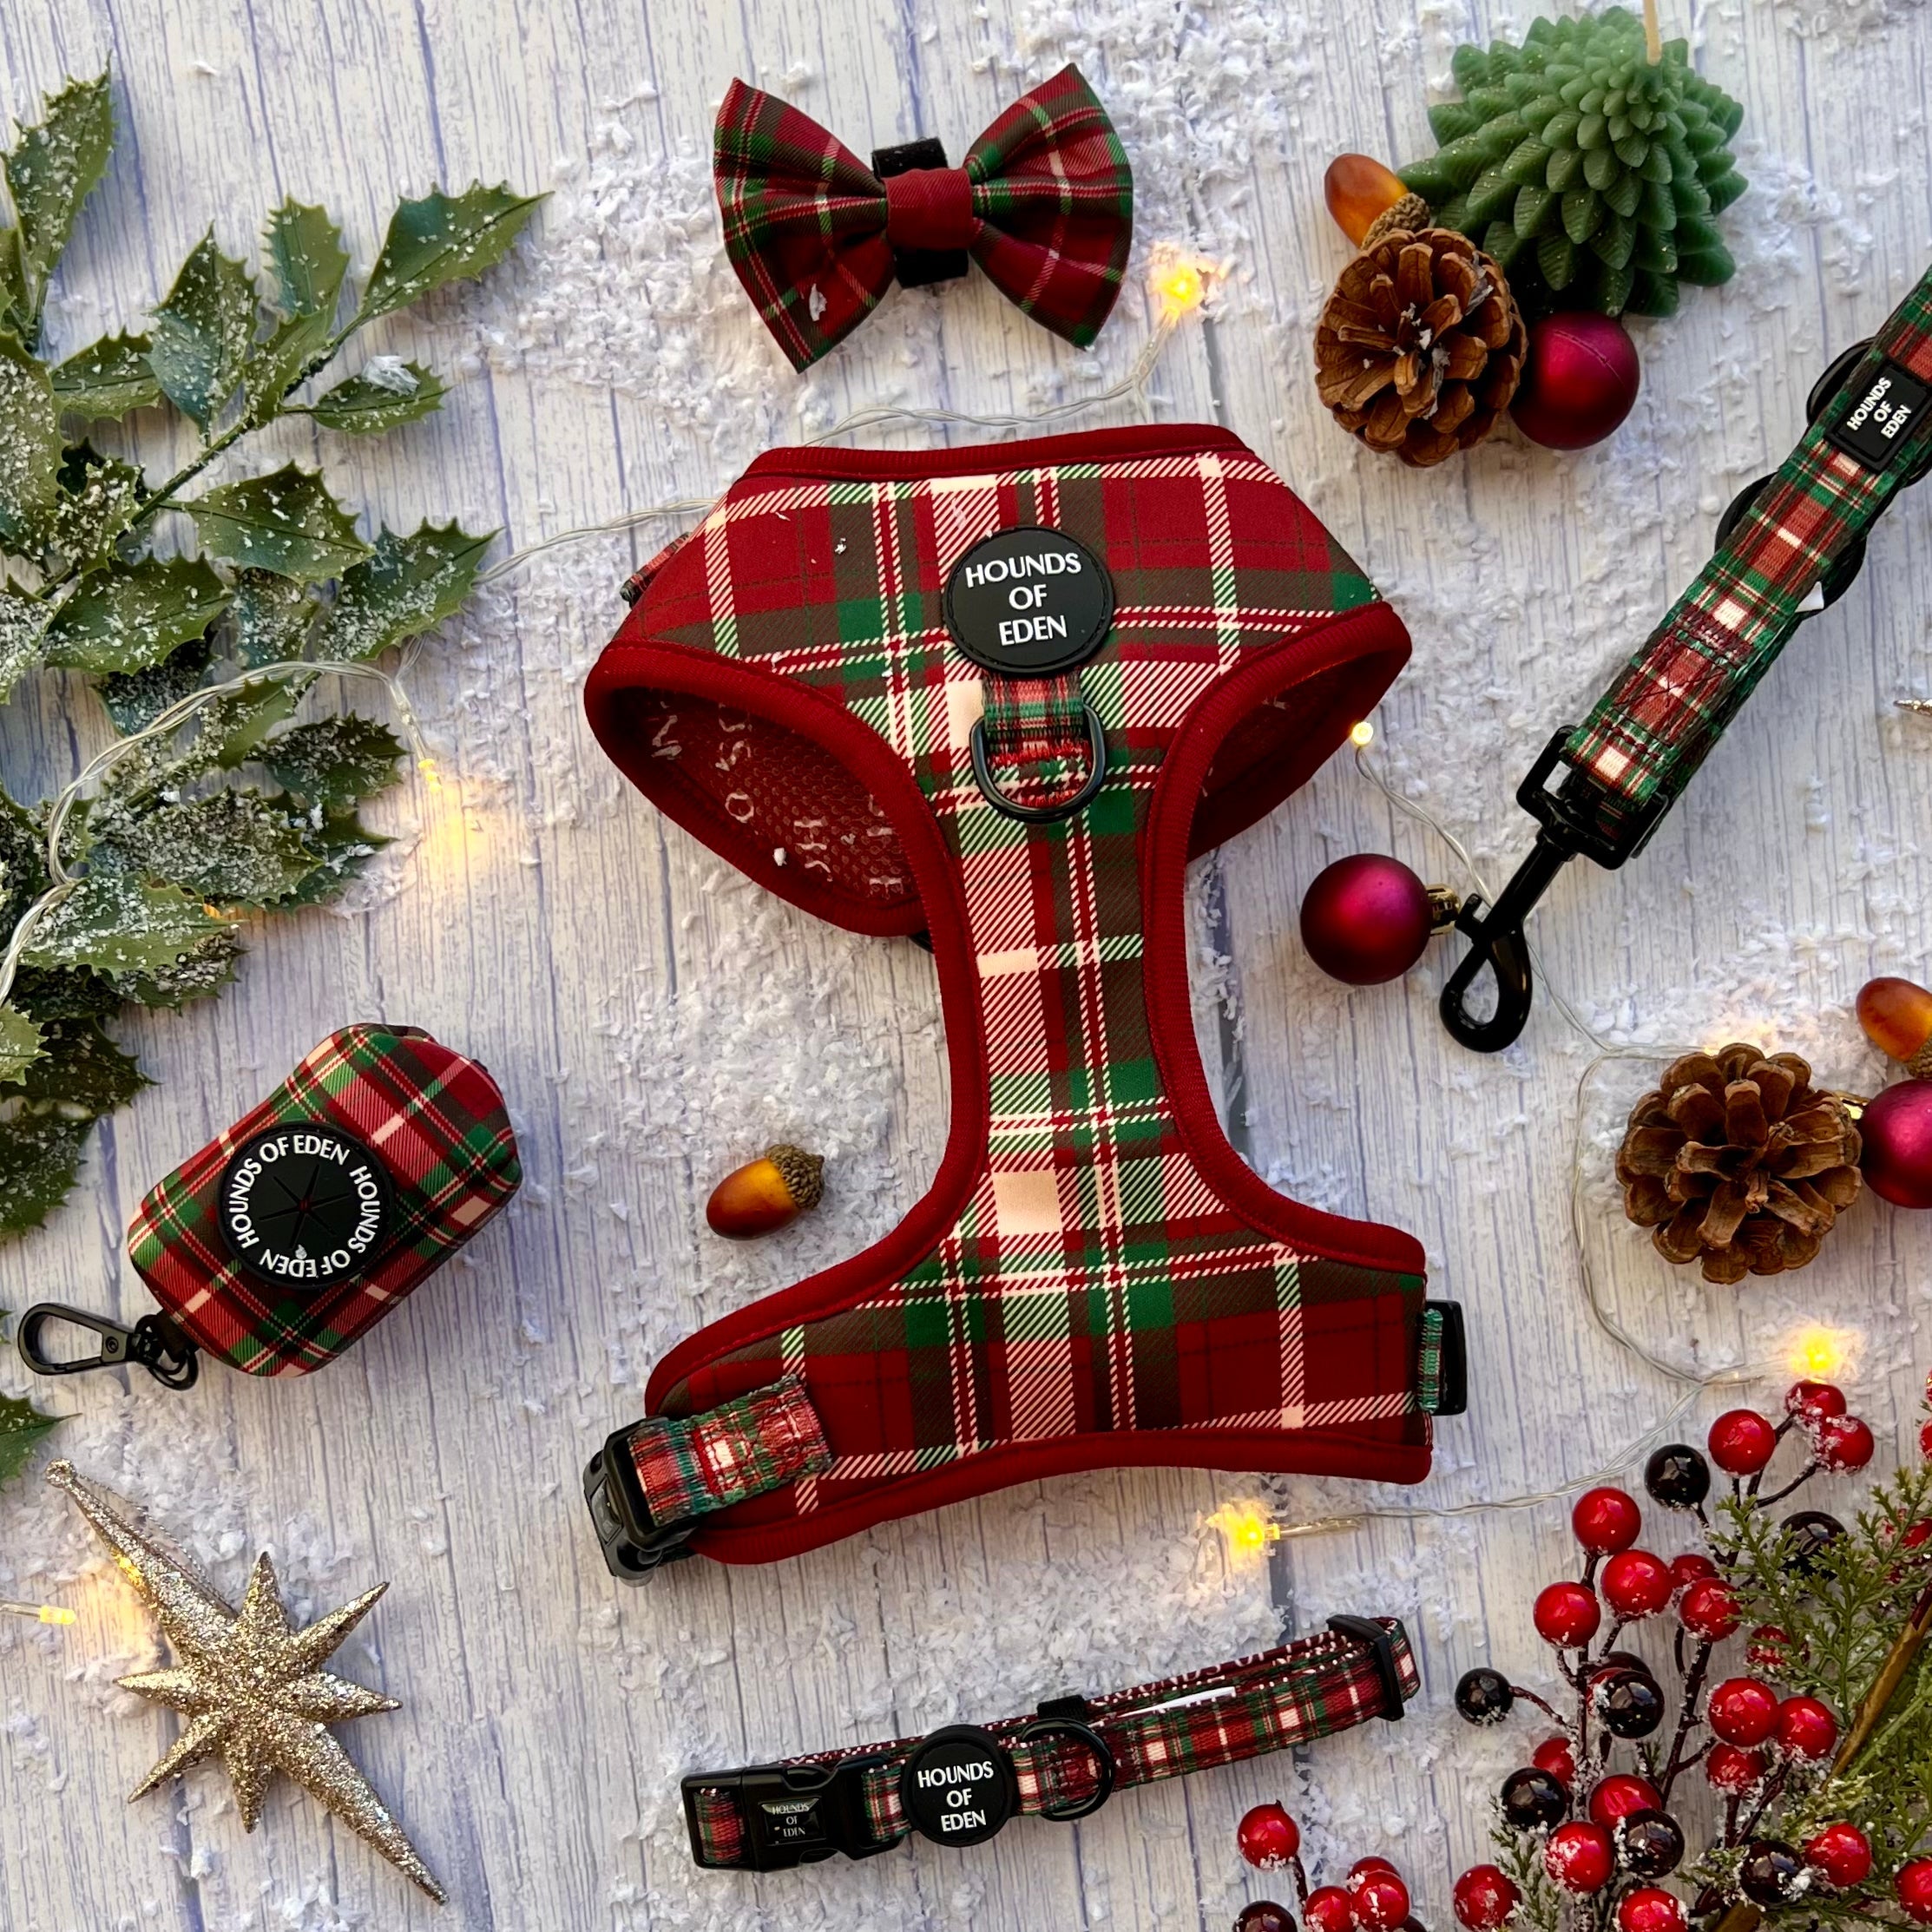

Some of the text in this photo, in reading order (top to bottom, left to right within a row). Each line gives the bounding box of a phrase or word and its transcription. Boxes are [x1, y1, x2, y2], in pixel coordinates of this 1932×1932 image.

[1846, 377, 1891, 430] HOUNDS
[1874, 400, 1892, 423] OF
[1881, 404, 1911, 439] EDEN
[965, 553, 1081, 588] HOUNDS
[1009, 584, 1048, 610] OF
[999, 614, 1068, 646] EDEN
[228, 1135, 350, 1249] HOUNDS OF EDEN
[259, 1166, 381, 1278] HOUNDS OF EDEN
[917, 1761, 994, 1788] HOUNDS
[946, 1788, 972, 1808] OF
[941, 1809, 987, 1832] EDEN
